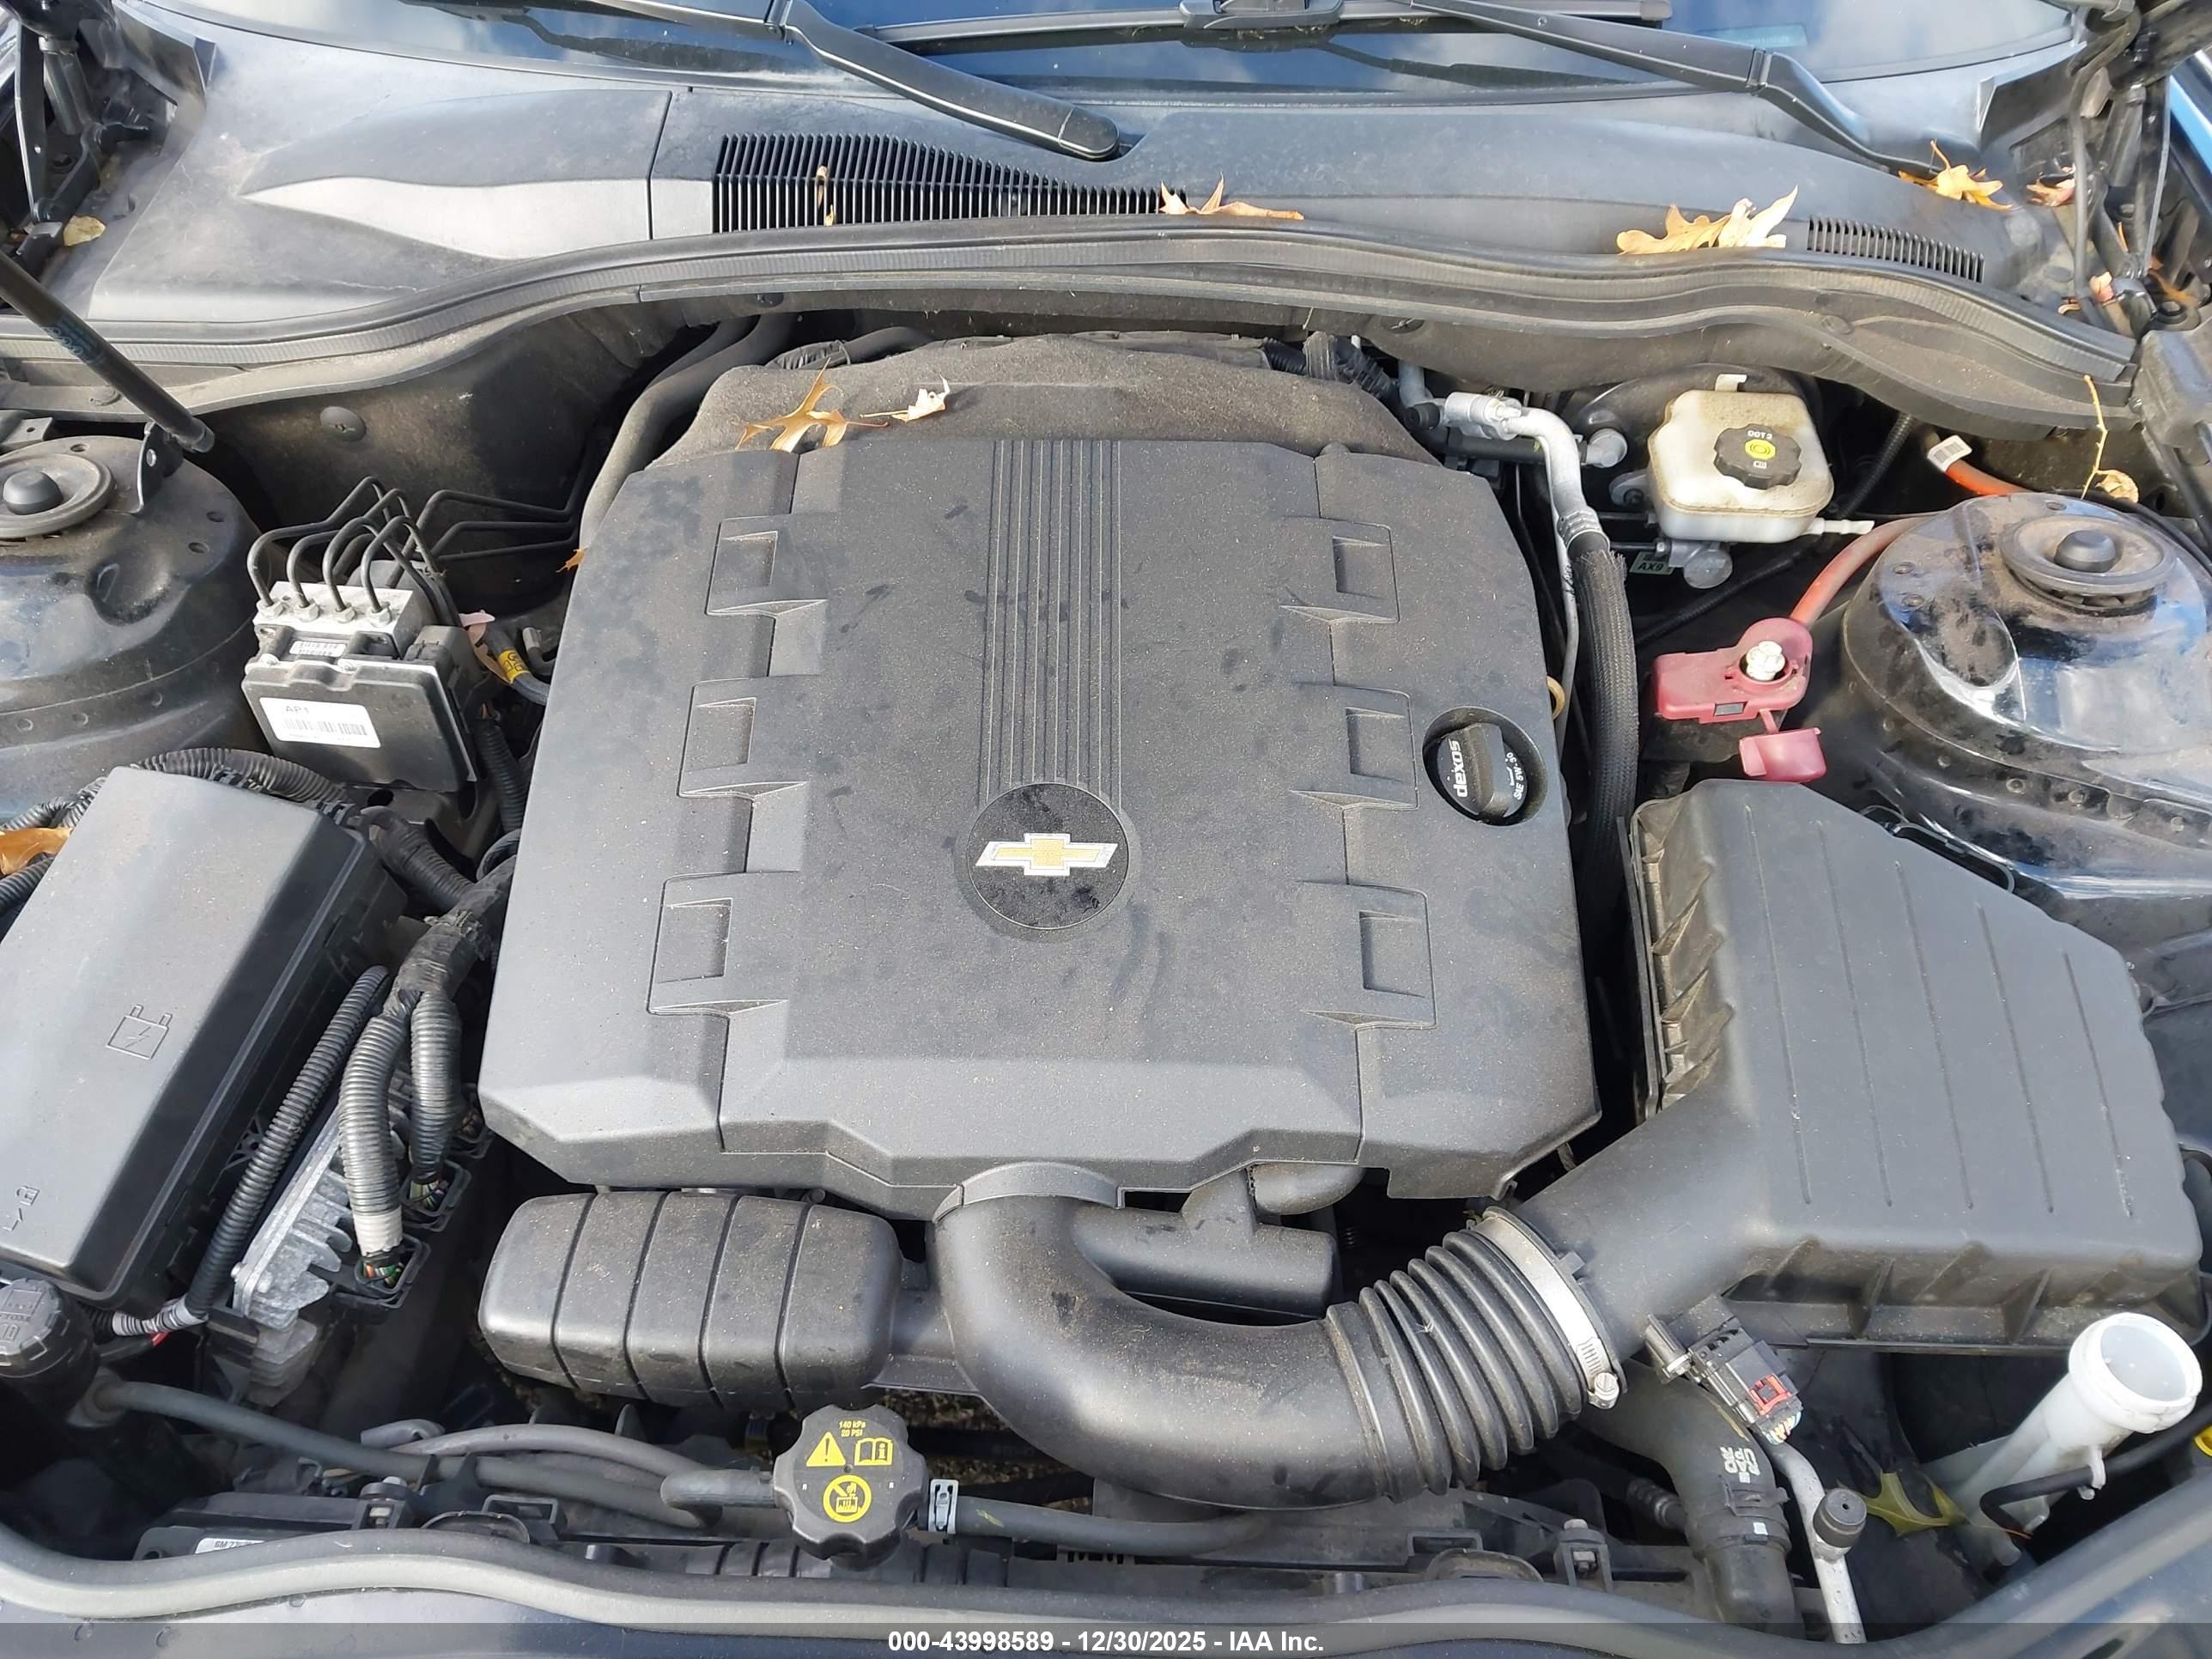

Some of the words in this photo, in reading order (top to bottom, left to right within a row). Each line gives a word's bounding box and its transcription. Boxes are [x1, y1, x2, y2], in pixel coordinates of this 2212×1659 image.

[1448, 738, 1468, 798] dexos
[1506, 751, 1524, 781] 5W-30
[1514, 783, 1524, 800] SAE
[1719, 1446, 1757, 1465] UPR
[1724, 1459, 1761, 1476] RAD
